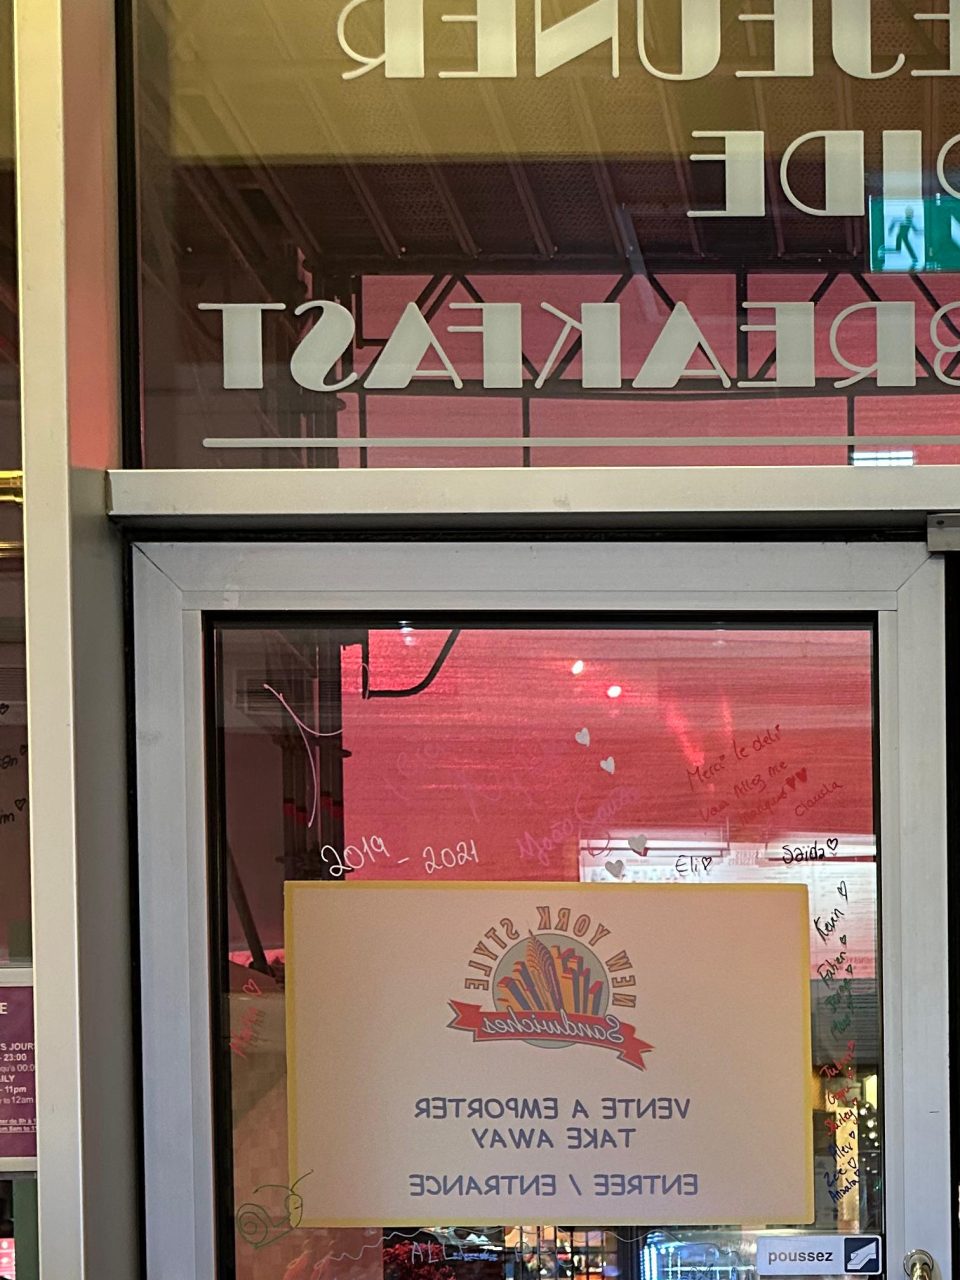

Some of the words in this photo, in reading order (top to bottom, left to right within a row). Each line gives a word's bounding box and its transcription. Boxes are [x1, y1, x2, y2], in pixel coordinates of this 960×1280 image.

[320, 835, 391, 877] 2019
[422, 839, 479, 874] 2021
[11, 1096, 34, 1104] 12am
[768, 1249, 833, 1264] poussez
